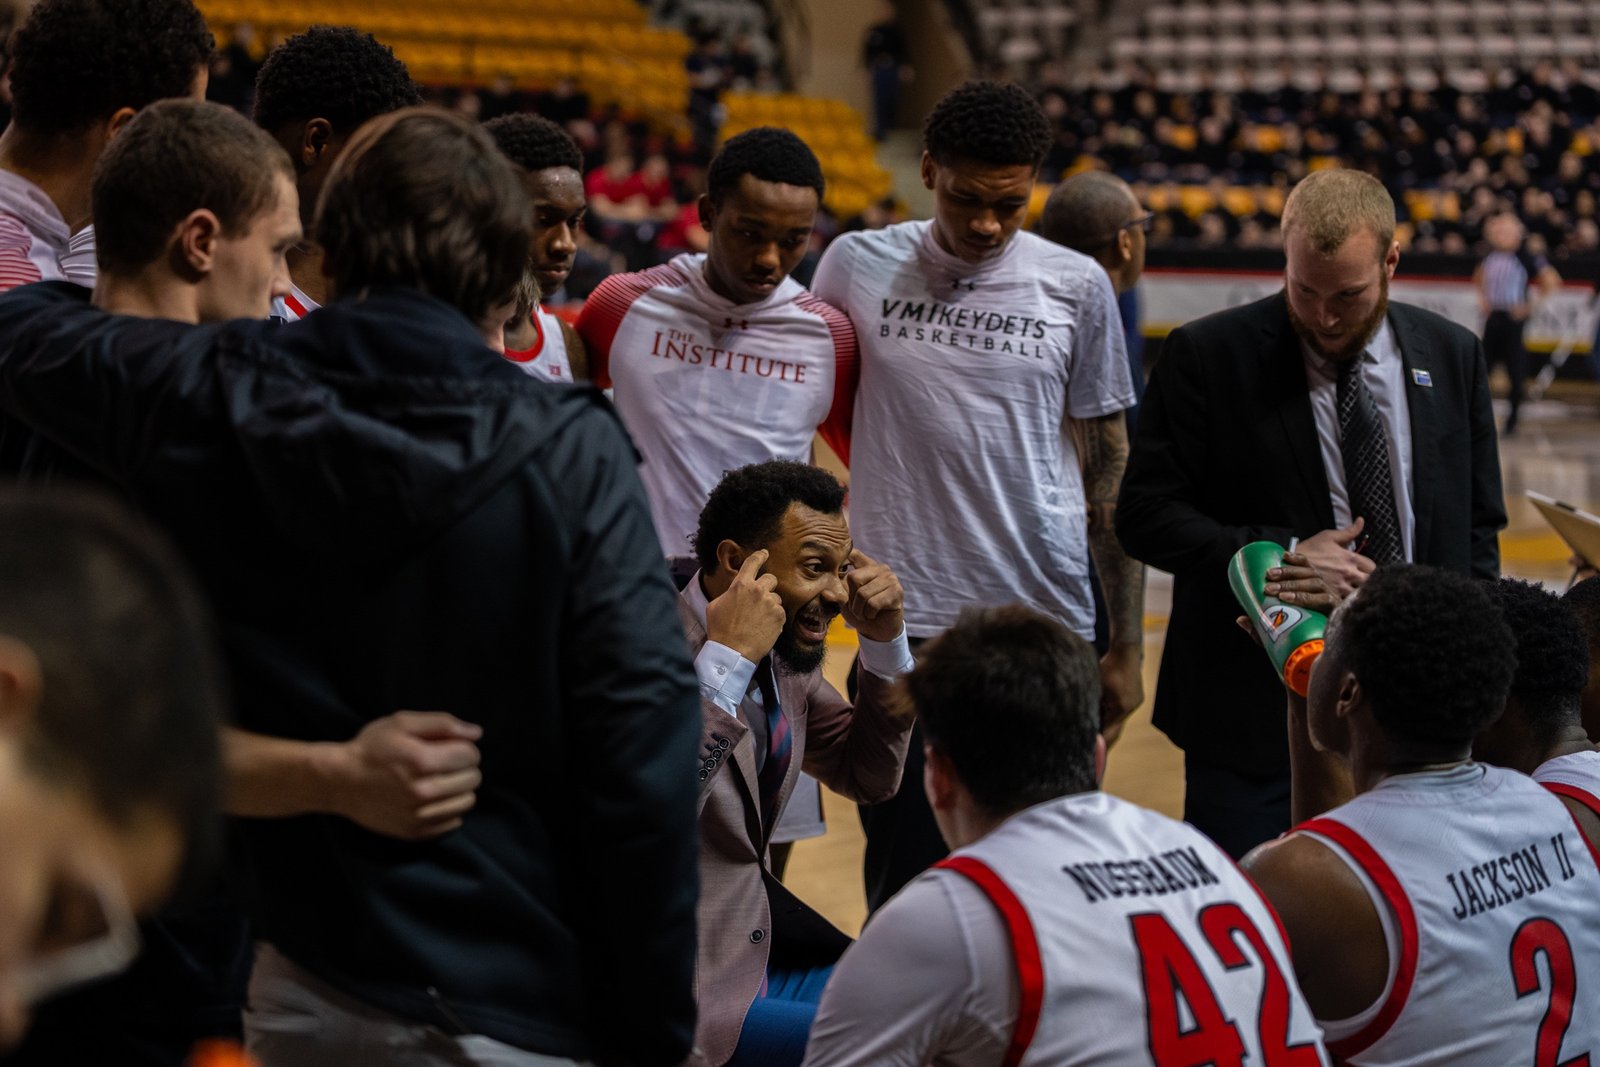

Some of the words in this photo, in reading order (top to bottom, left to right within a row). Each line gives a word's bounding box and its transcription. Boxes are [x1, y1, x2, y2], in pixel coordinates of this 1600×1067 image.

[651, 331, 807, 384] INSTITUTE
[668, 328, 695, 343] THE
[880, 324, 1044, 359] BASKETBALL
[1446, 843, 1551, 921] JACKSON
[1129, 903, 1328, 1067] 42
[1510, 916, 1590, 1067] 2
